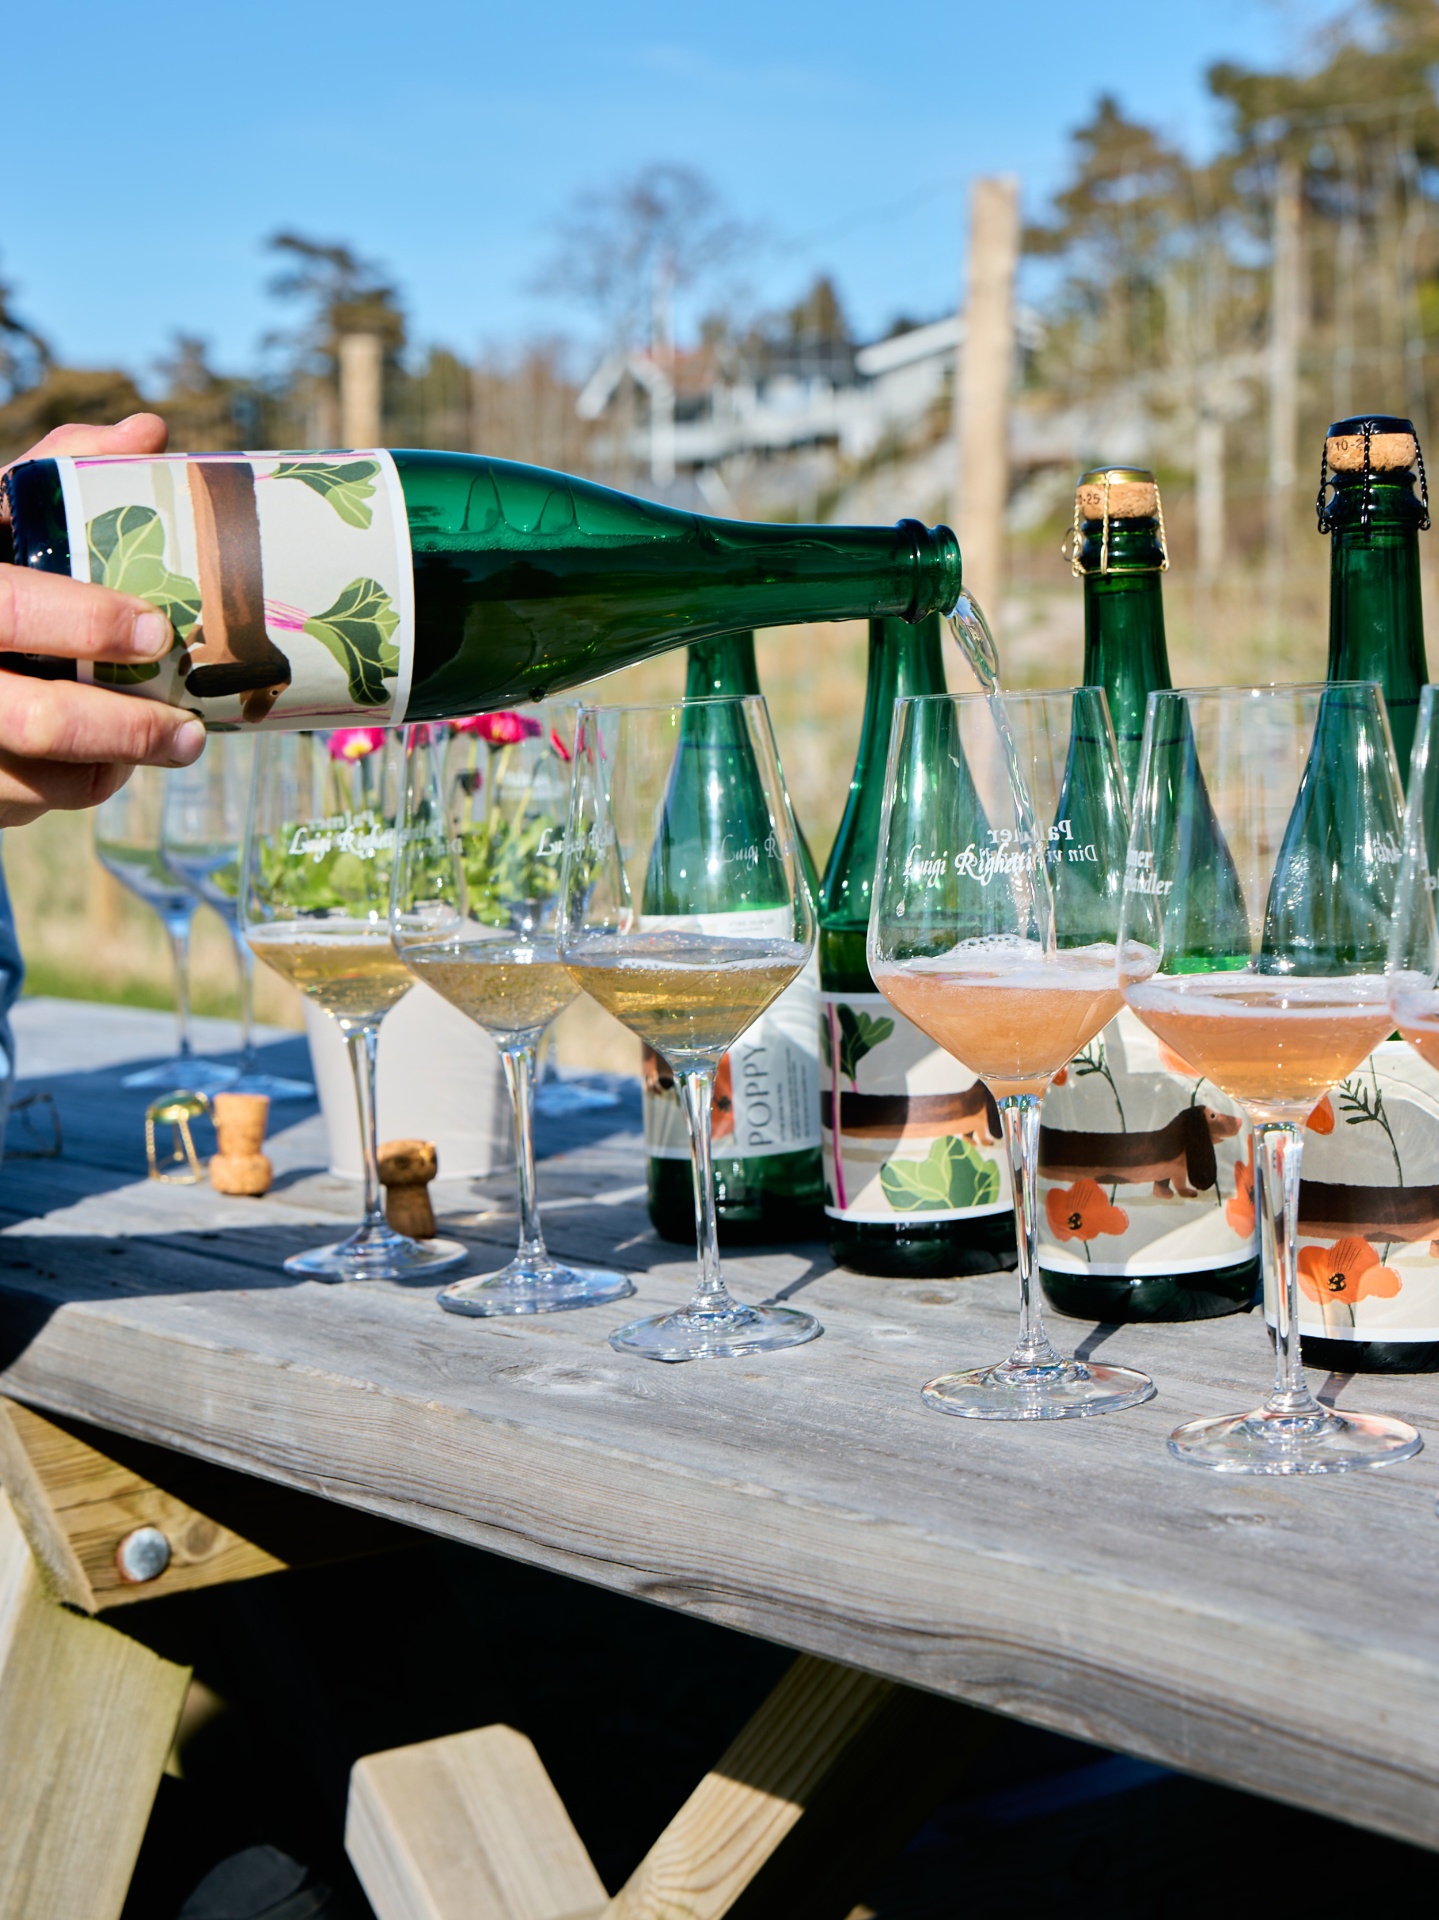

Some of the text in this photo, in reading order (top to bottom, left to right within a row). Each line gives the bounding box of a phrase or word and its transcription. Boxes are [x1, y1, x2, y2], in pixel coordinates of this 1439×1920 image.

[718, 834, 759, 872] Luigi
[902, 842, 1033, 889] Luigi Righetti
[743, 1043, 774, 1147] POPPY
